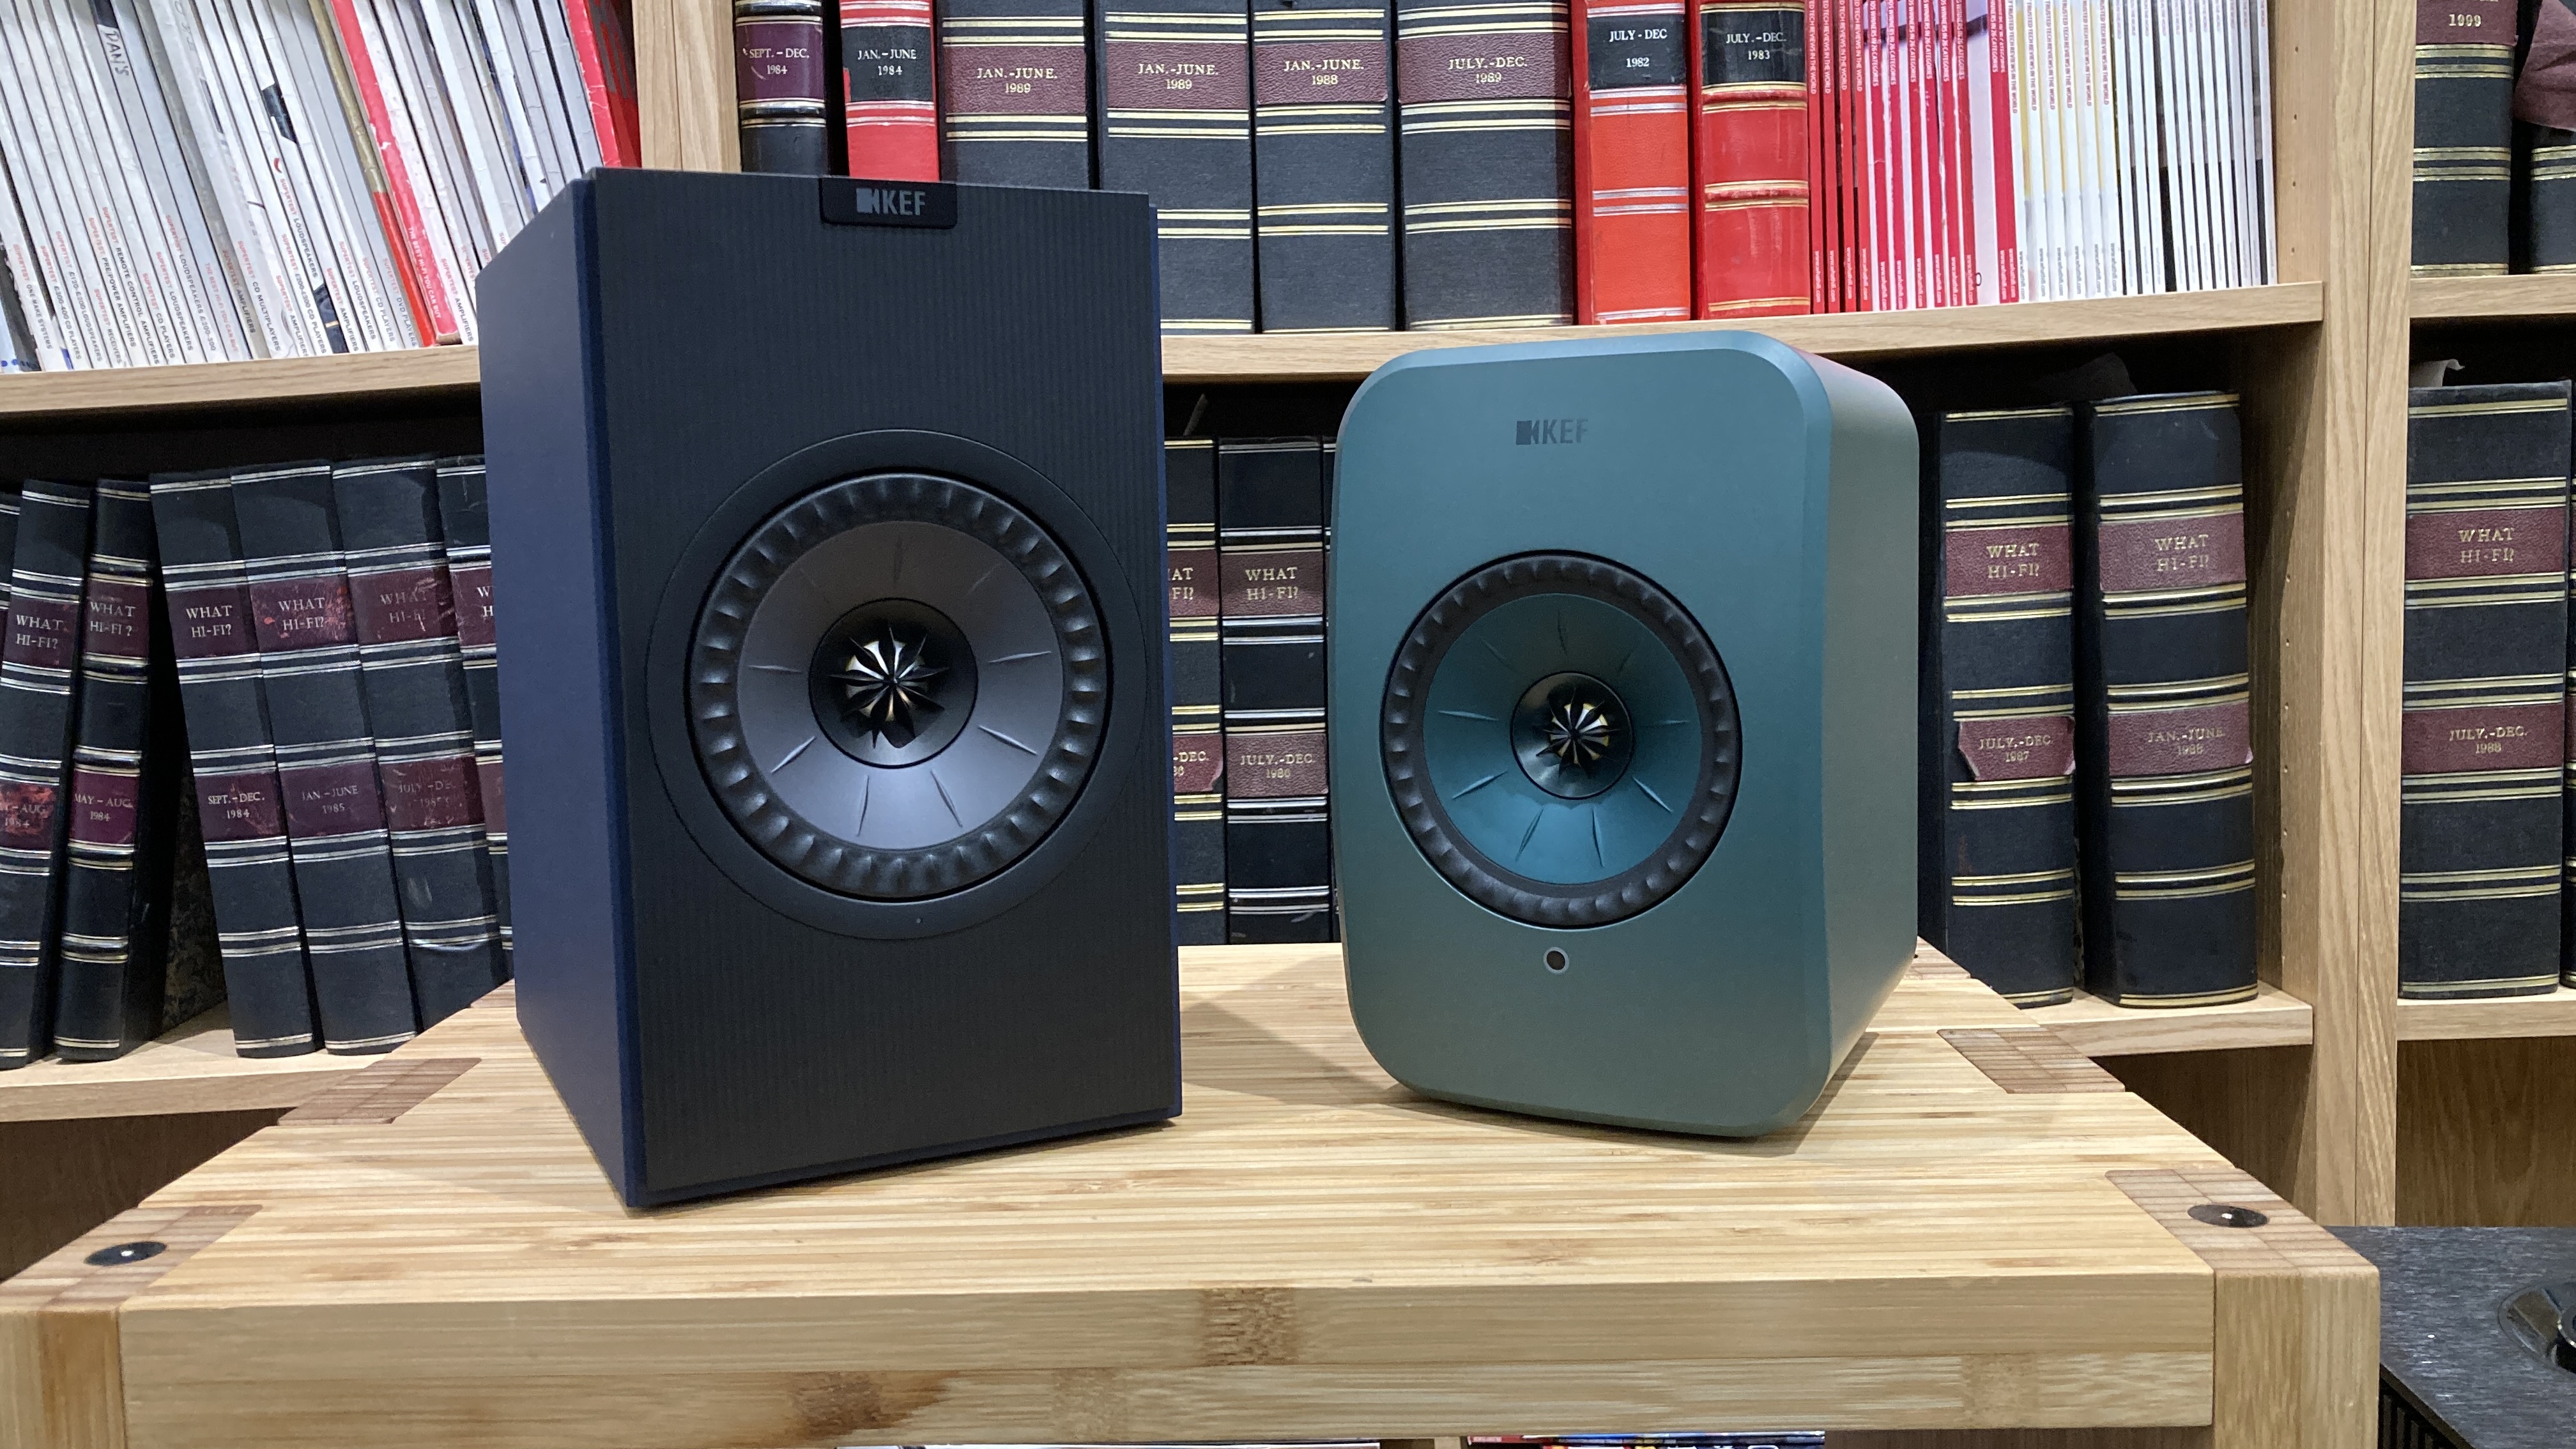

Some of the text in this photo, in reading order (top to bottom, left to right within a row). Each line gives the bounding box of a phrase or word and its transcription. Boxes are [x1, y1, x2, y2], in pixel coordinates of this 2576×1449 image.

[104, 31, 129, 76] DAN'S
[1748, 50, 1770, 60] 1983
[1627, 57, 1650, 67] 1982
[767, 65, 787, 75] 1984
[878, 66, 902, 75] 1984
[1476, 72, 1501, 83] 1989
[1005, 83, 1031, 93] 1989
[1166, 79, 1192, 89] 1989
[1312, 75, 1338, 86] 1988
[408, 226, 417, 240] THE
[294, 218, 318, 278] LOUDSPEAKERS
[412, 240, 422, 258] BEST
[179, 254, 203, 314] LOUDSPEAKERS
[423, 275, 432, 289] YOU
[376, 296, 384, 308] CD
[427, 289, 437, 304] CAN
[116, 247, 131, 279] REMOTE
[127, 280, 144, 318] CONTROL
[141, 319, 160, 365] AMPLIFIERS
[236, 288, 256, 334] AMPLIFIERS
[352, 280, 376, 340] LOUDSPEAKERS
[433, 305, 441, 319] BUY
[26, 284, 35, 298] ONE
[31, 299, 42, 318] MAKE
[38, 318, 52, 349] SYSTEMS
[169, 291, 193, 351] LOUDSPEAKERS
[252, 281, 260, 293] CD
[257, 295, 281, 351] MULTIPLAYERS
[396, 296, 406, 312] DVD
[402, 314, 418, 347] PLAYERS
[455, 297, 473, 342] AMPLIFIERS
[117, 302, 136, 348] AMPLIFIERS
[307, 309, 315, 320] CD
[311, 321, 326, 354] PLAYERS
[340, 307, 359, 351] AMPLIFIERS
[379, 309, 395, 342] PLAYERS
[82, 310, 103, 362] LOUDSPEAKERS
[156, 312, 164, 324] CD
[160, 325, 175, 358] PLAYERS
[68, 330, 82, 360] PLAYERS
[107, 328, 123, 364] RECEIVERS
[2457, 527, 2515, 542] WHAT
[2154, 534, 2209, 551] WHAT
[1986, 543, 2039, 558] WHAT
[2460, 548, 2515, 563] HI-FI?
[2156, 555, 2209, 572] HI-FI?
[1245, 567, 1298, 581] WHAT
[1988, 564, 2040, 579] HI-FI?
[90, 602, 137, 617] WHAT
[279, 597, 325, 612] WHAT
[186, 605, 233, 620] WHAT
[16, 615, 64, 630] WHAT
[282, 617, 324, 631] HI-FI?
[192, 624, 231, 638] HI-FI?
[15, 634, 58, 649] HI-FI?
[2475, 742, 2502, 754] 1988
[2005, 751, 2030, 763] 1987
[226, 809, 250, 819] 1984
[322, 803, 345, 814] 1985
[90, 811, 110, 822] 1984
